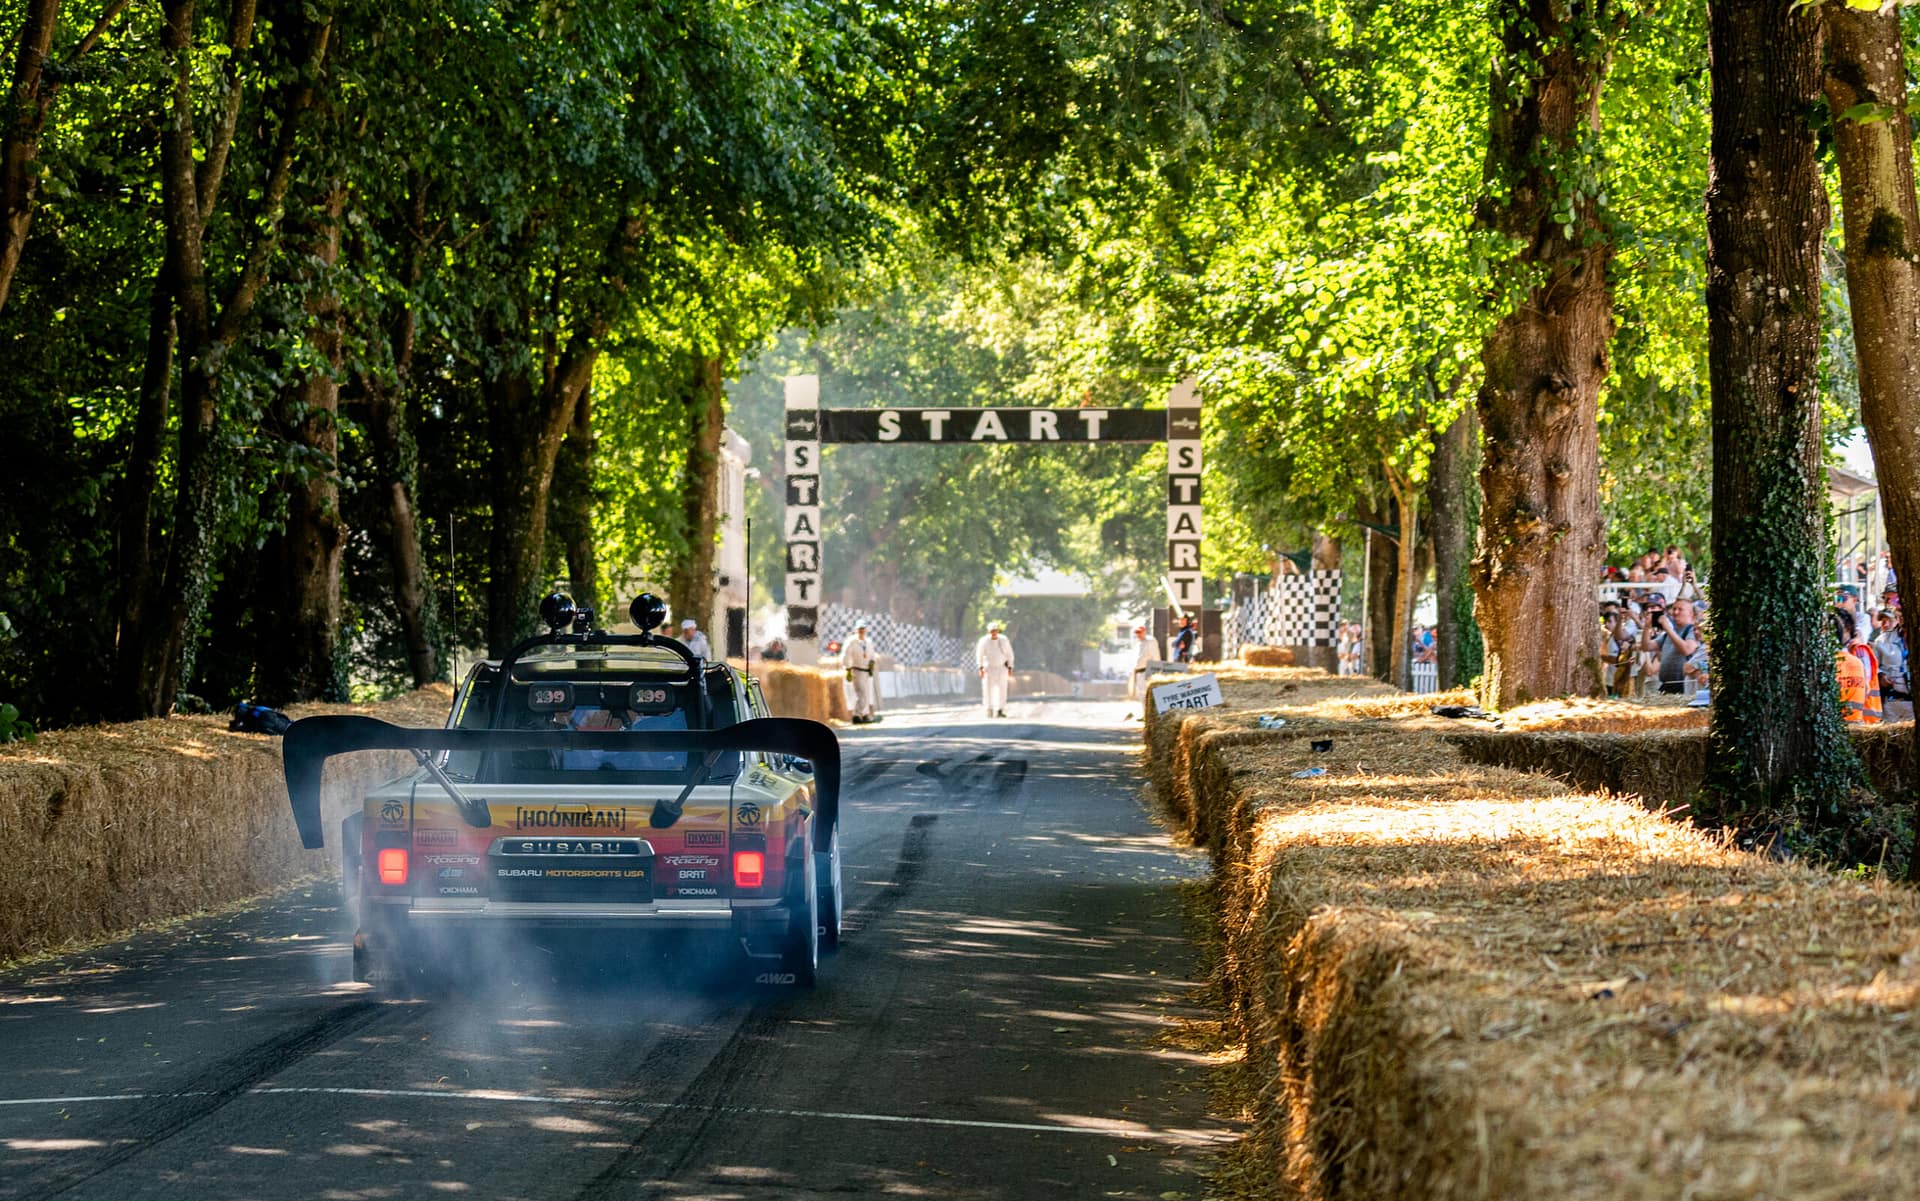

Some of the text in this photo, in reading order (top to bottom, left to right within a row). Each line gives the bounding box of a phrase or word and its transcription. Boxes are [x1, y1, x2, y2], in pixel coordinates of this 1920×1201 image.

[878, 410, 1108, 441] START
[790, 446, 816, 600] START
[1173, 446, 1198, 600] START
[535, 690, 565, 703] 199
[636, 689, 666, 703] 199
[1162, 693, 1178, 703] TYRE
[1180, 684, 1212, 699] WARMING
[521, 842, 620, 853] SUBARU
[498, 869, 542, 877] SUBARU
[546, 869, 621, 877] MOTORSPORTS
[679, 870, 706, 879] BRAT
